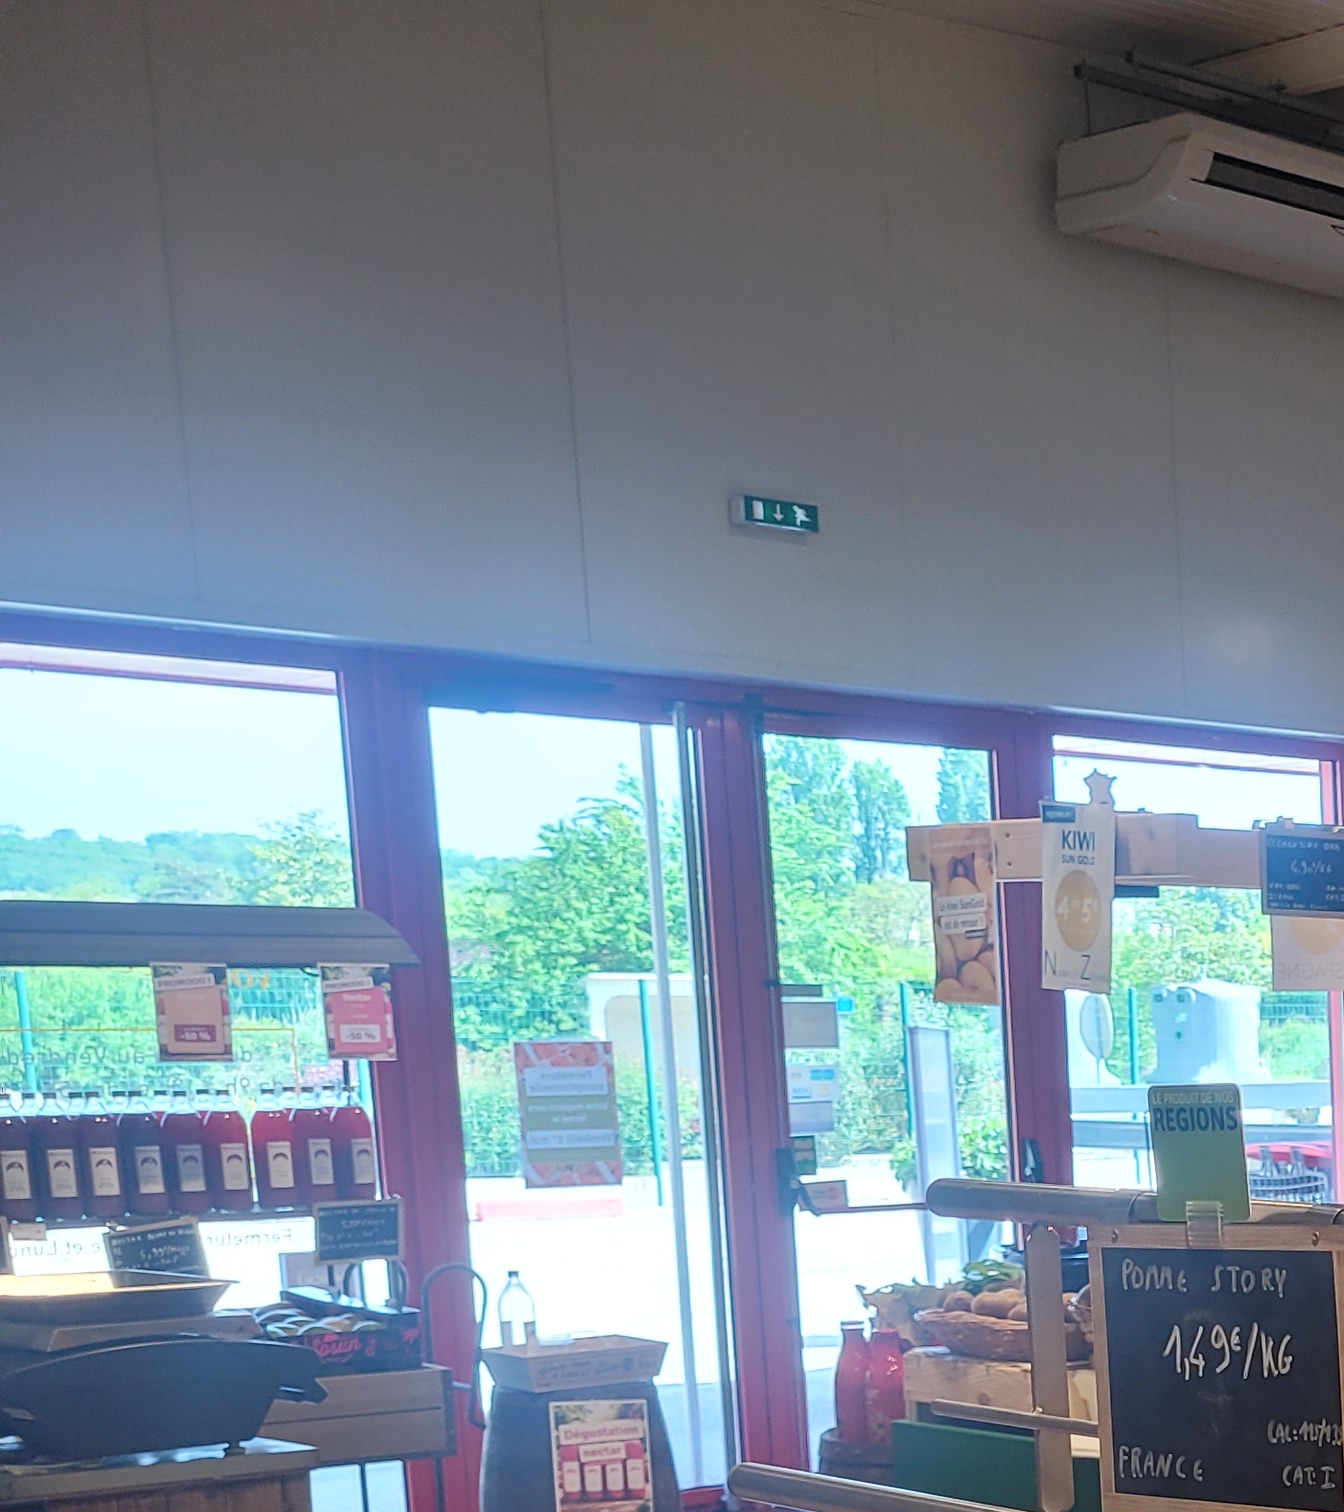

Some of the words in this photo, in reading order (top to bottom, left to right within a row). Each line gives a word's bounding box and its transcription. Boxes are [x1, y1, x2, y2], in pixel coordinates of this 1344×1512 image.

[1061, 830, 1096, 852] KIWI
[1061, 854, 1075, 864] SUN
[1154, 1106, 1239, 1132] REGIONS
[1121, 1258, 1188, 1294] POMME
[1211, 1265, 1288, 1299] STORY
[563, 1426, 640, 1441] Dégustation
[583, 1445, 622, 1457] nectar
[1118, 1445, 1204, 1482] FRANCE
